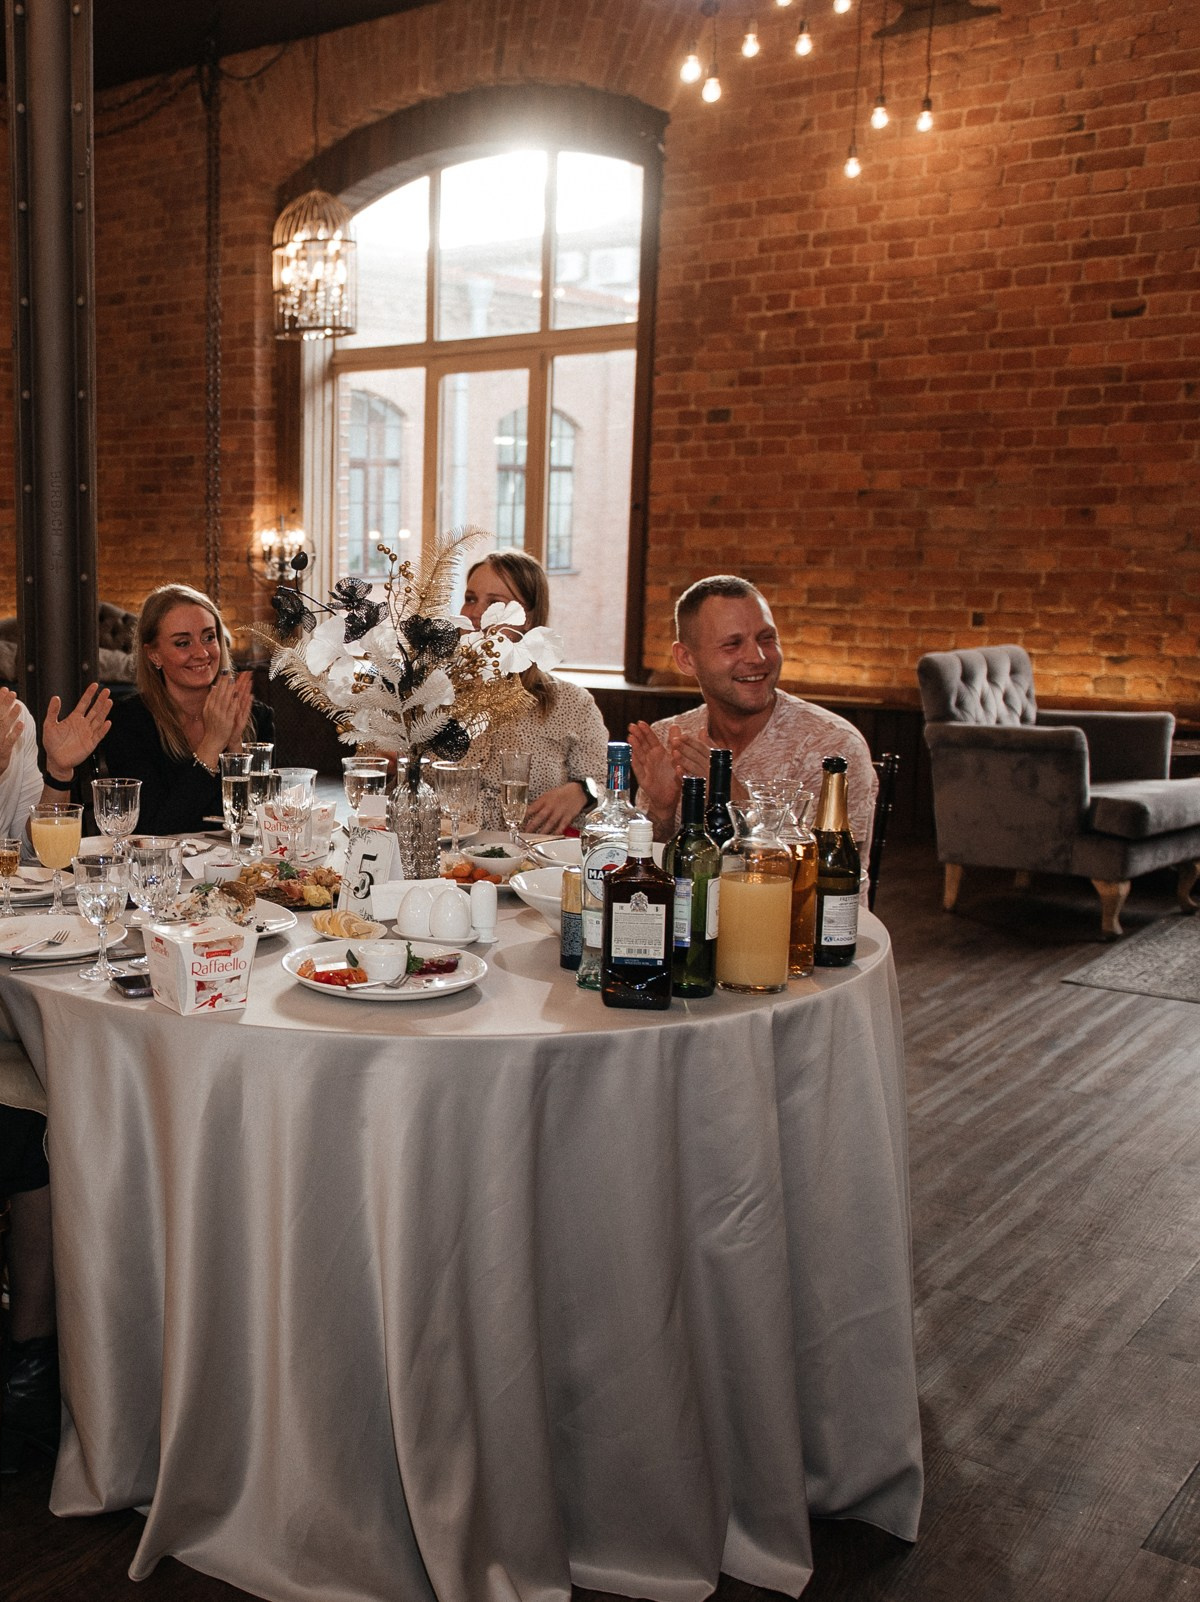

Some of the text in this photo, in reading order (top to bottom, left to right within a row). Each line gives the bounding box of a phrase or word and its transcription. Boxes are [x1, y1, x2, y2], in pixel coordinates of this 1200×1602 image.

[264, 820, 302, 834] Raffao
[353, 853, 379, 899] 5
[191, 957, 247, 977] Raffaello
